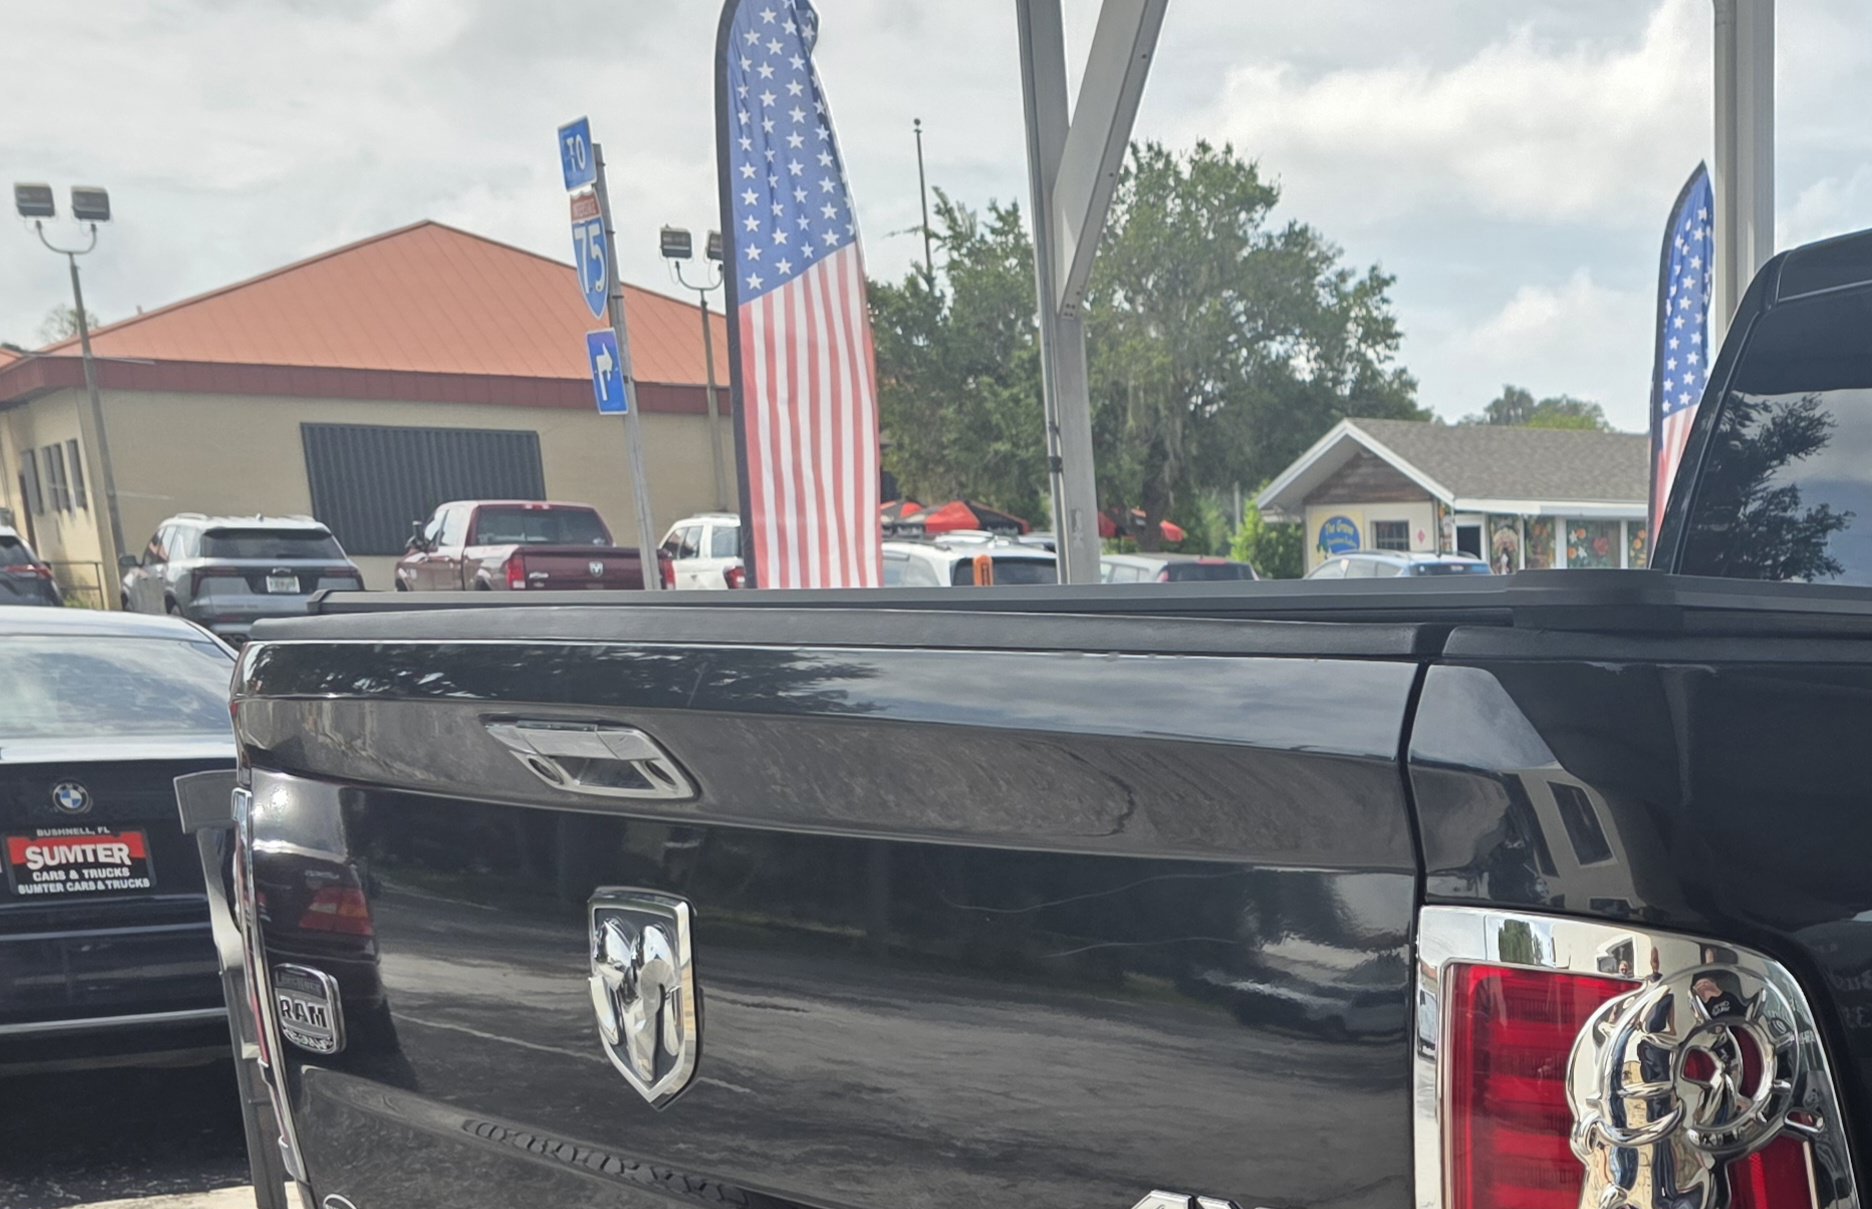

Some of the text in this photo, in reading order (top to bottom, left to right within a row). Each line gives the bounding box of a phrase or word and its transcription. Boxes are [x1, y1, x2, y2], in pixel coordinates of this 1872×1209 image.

[566, 134, 587, 172] TO
[574, 223, 605, 294] 75
[37, 826, 110, 837] BUSHNELL, FL
[25, 842, 132, 870] SUMTER
[17, 882, 64, 895] SUMTER
[66, 880, 96, 892] CARS
[105, 878, 150, 890] TRUCKS
[32, 867, 130, 882] CARS & TRUCKS
[279, 995, 328, 1028] RAM
